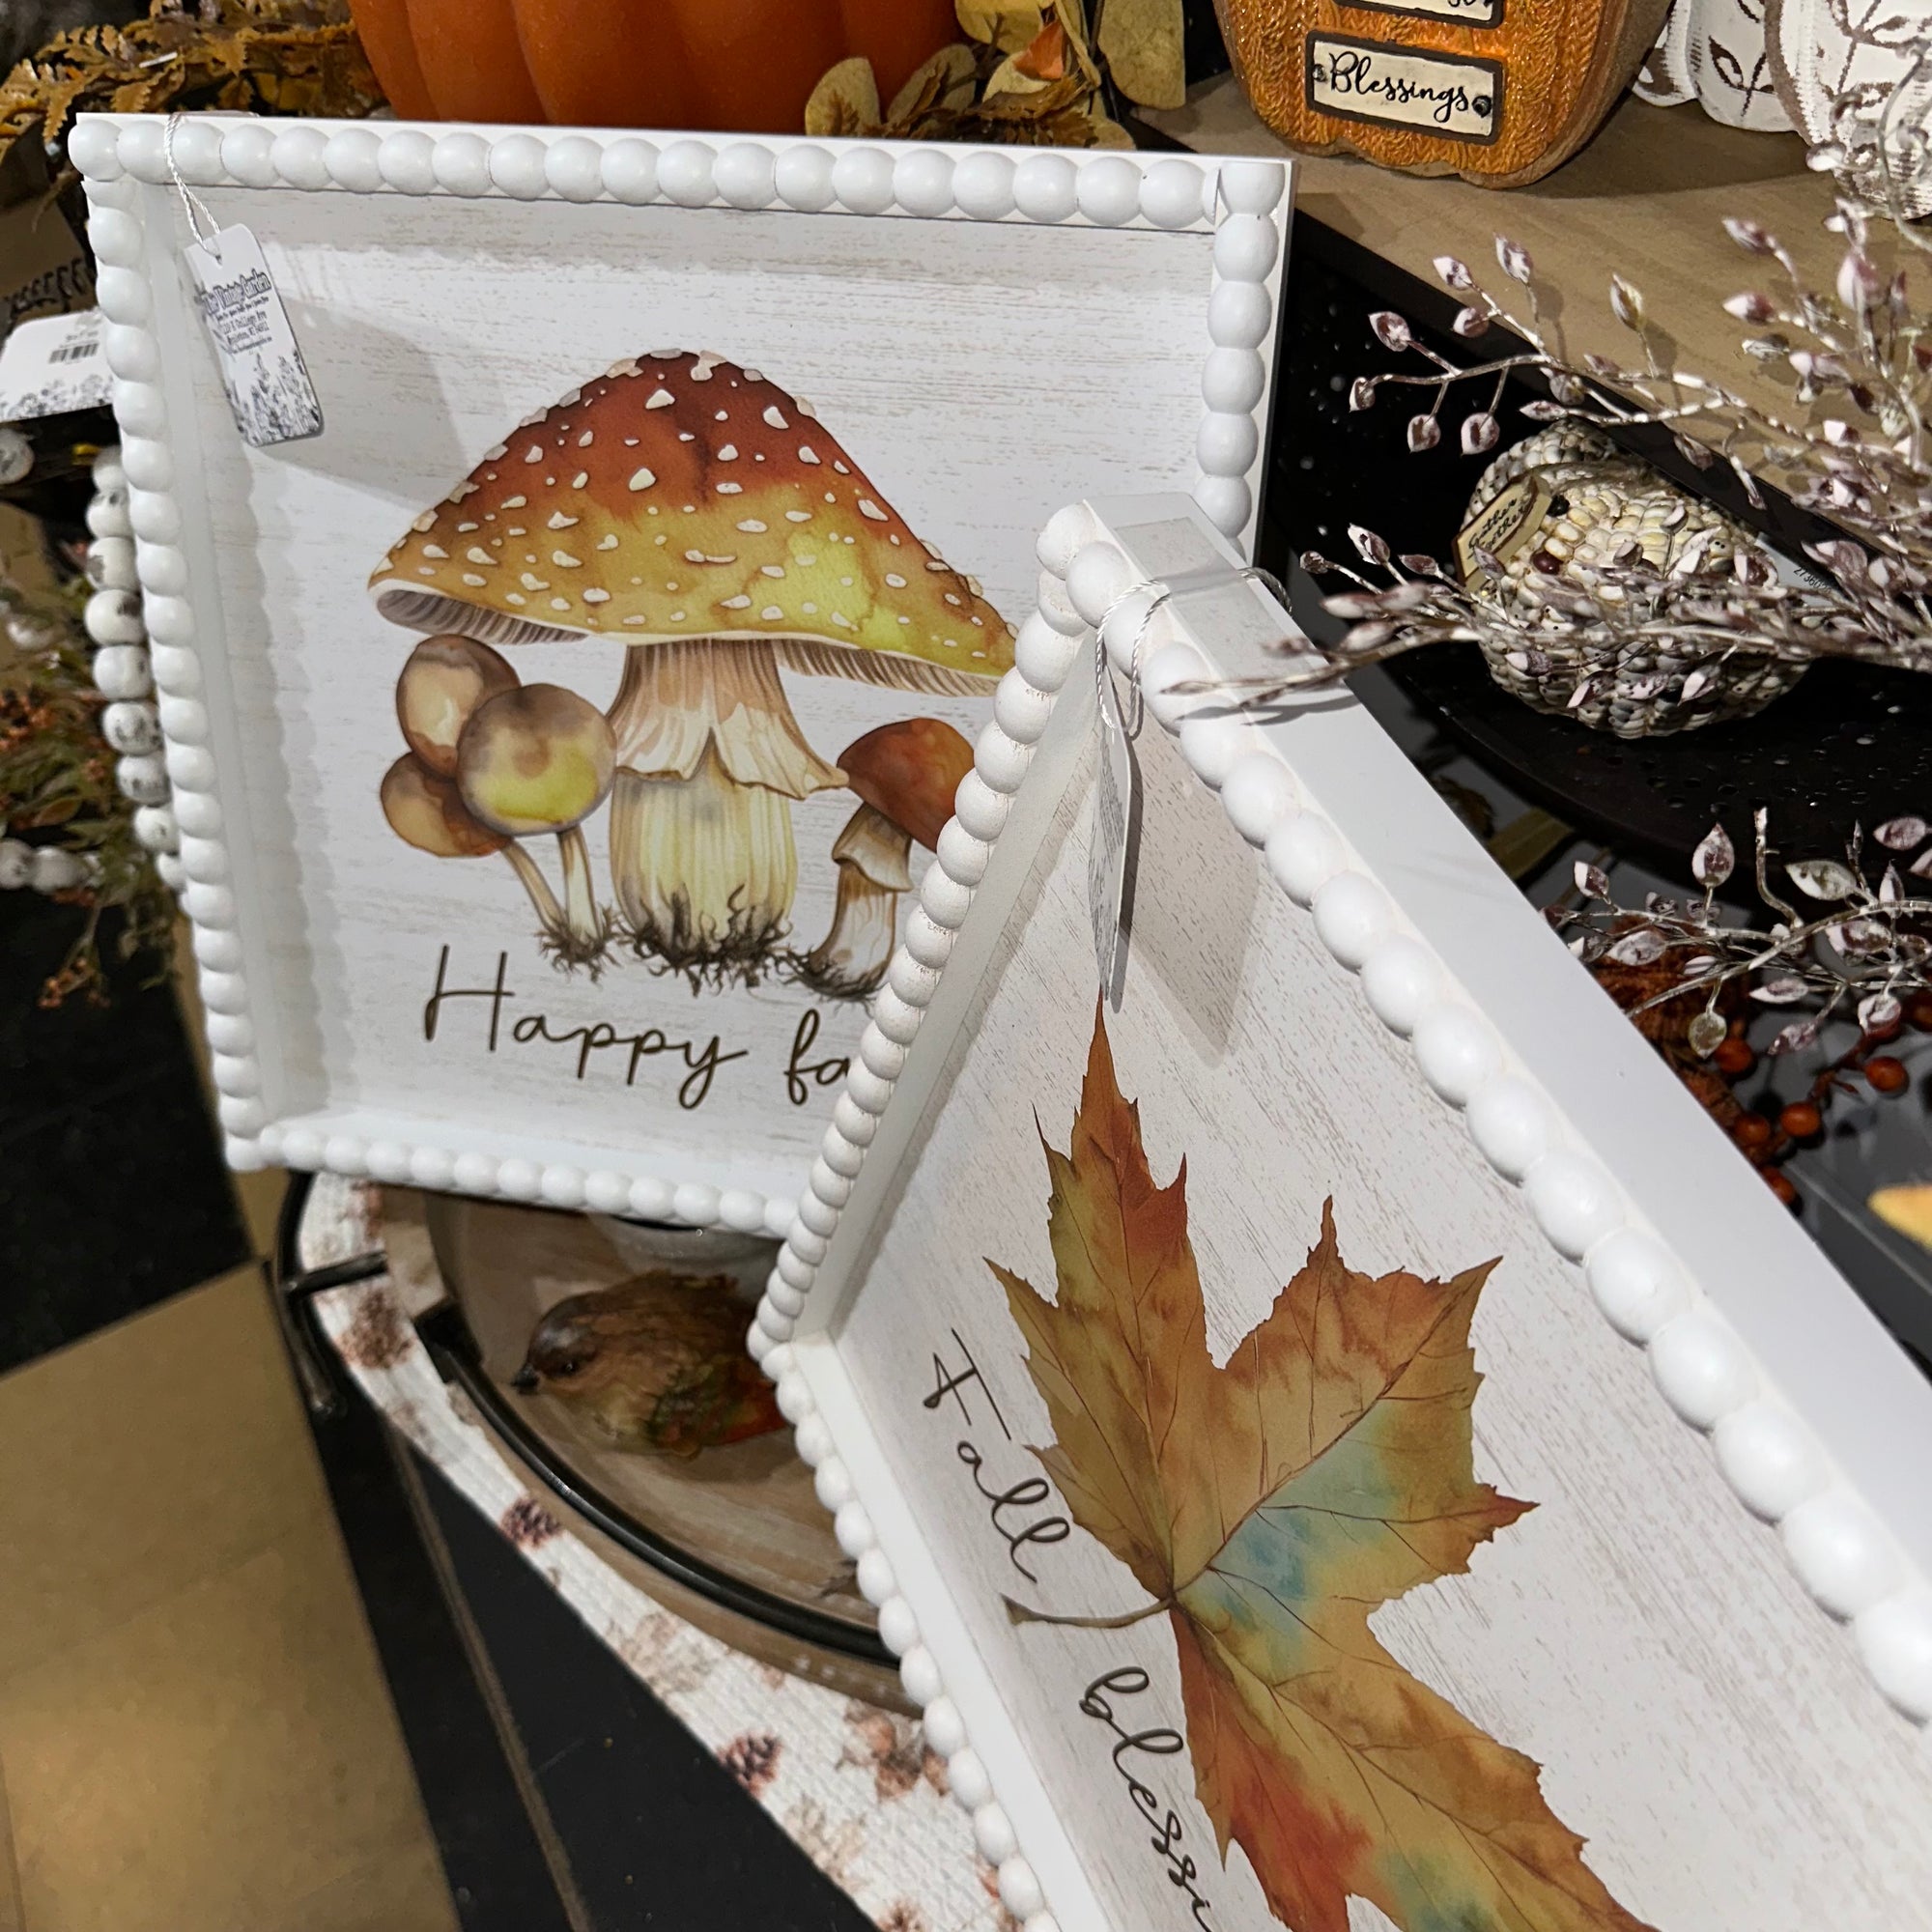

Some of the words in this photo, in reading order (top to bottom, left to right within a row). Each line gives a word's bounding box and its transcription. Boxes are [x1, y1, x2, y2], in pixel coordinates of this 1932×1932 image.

[1329, 51, 1468, 123] Blessings
[1467, 505, 1524, 560] gether
[424, 944, 749, 1110] Happy
[784, 1009, 850, 1106] fa
[923, 1327, 1070, 1584] Fall
[1079, 1665, 1212, 1932] blessi
